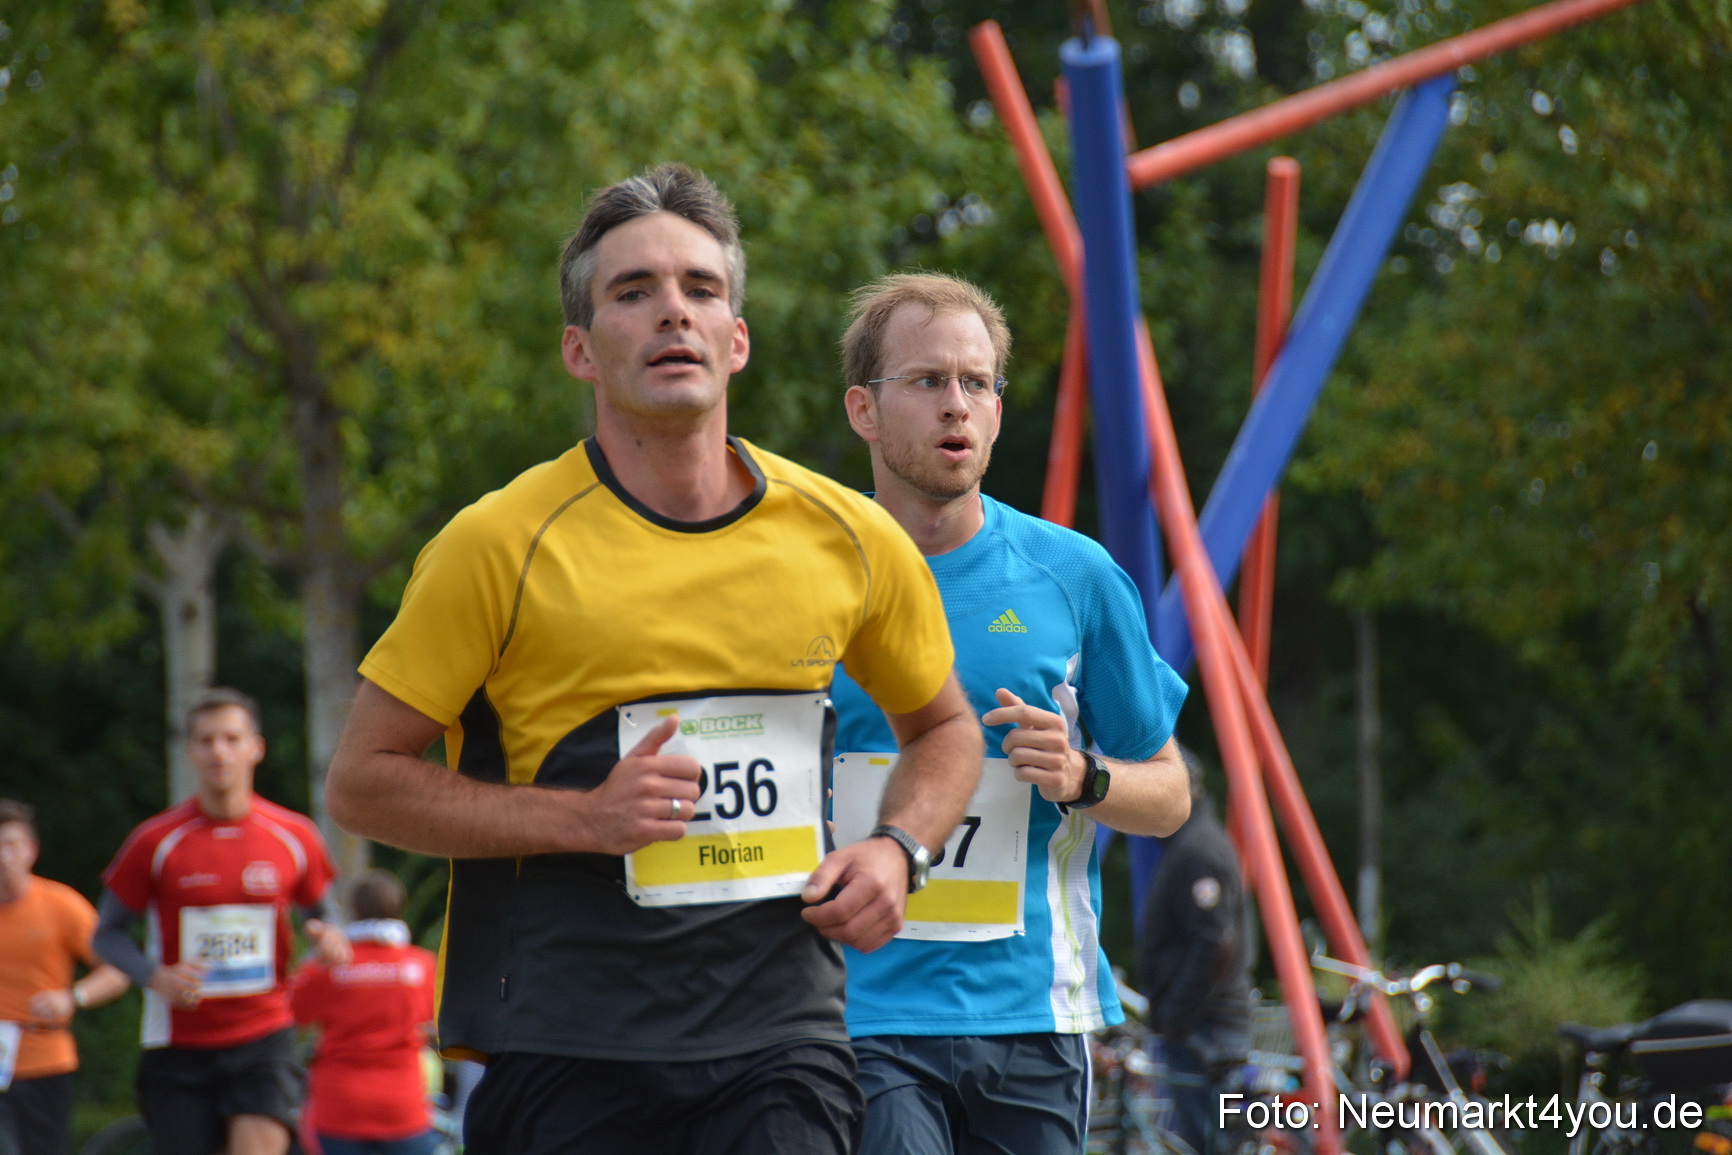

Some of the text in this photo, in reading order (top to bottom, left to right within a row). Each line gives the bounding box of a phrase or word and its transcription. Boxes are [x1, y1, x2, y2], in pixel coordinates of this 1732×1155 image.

[987, 623, 1028, 634] adidas
[790, 658, 804, 667] LA
[700, 713, 764, 734] BOCK
[929, 815, 982, 868] 7
[699, 842, 764, 866] Florian
